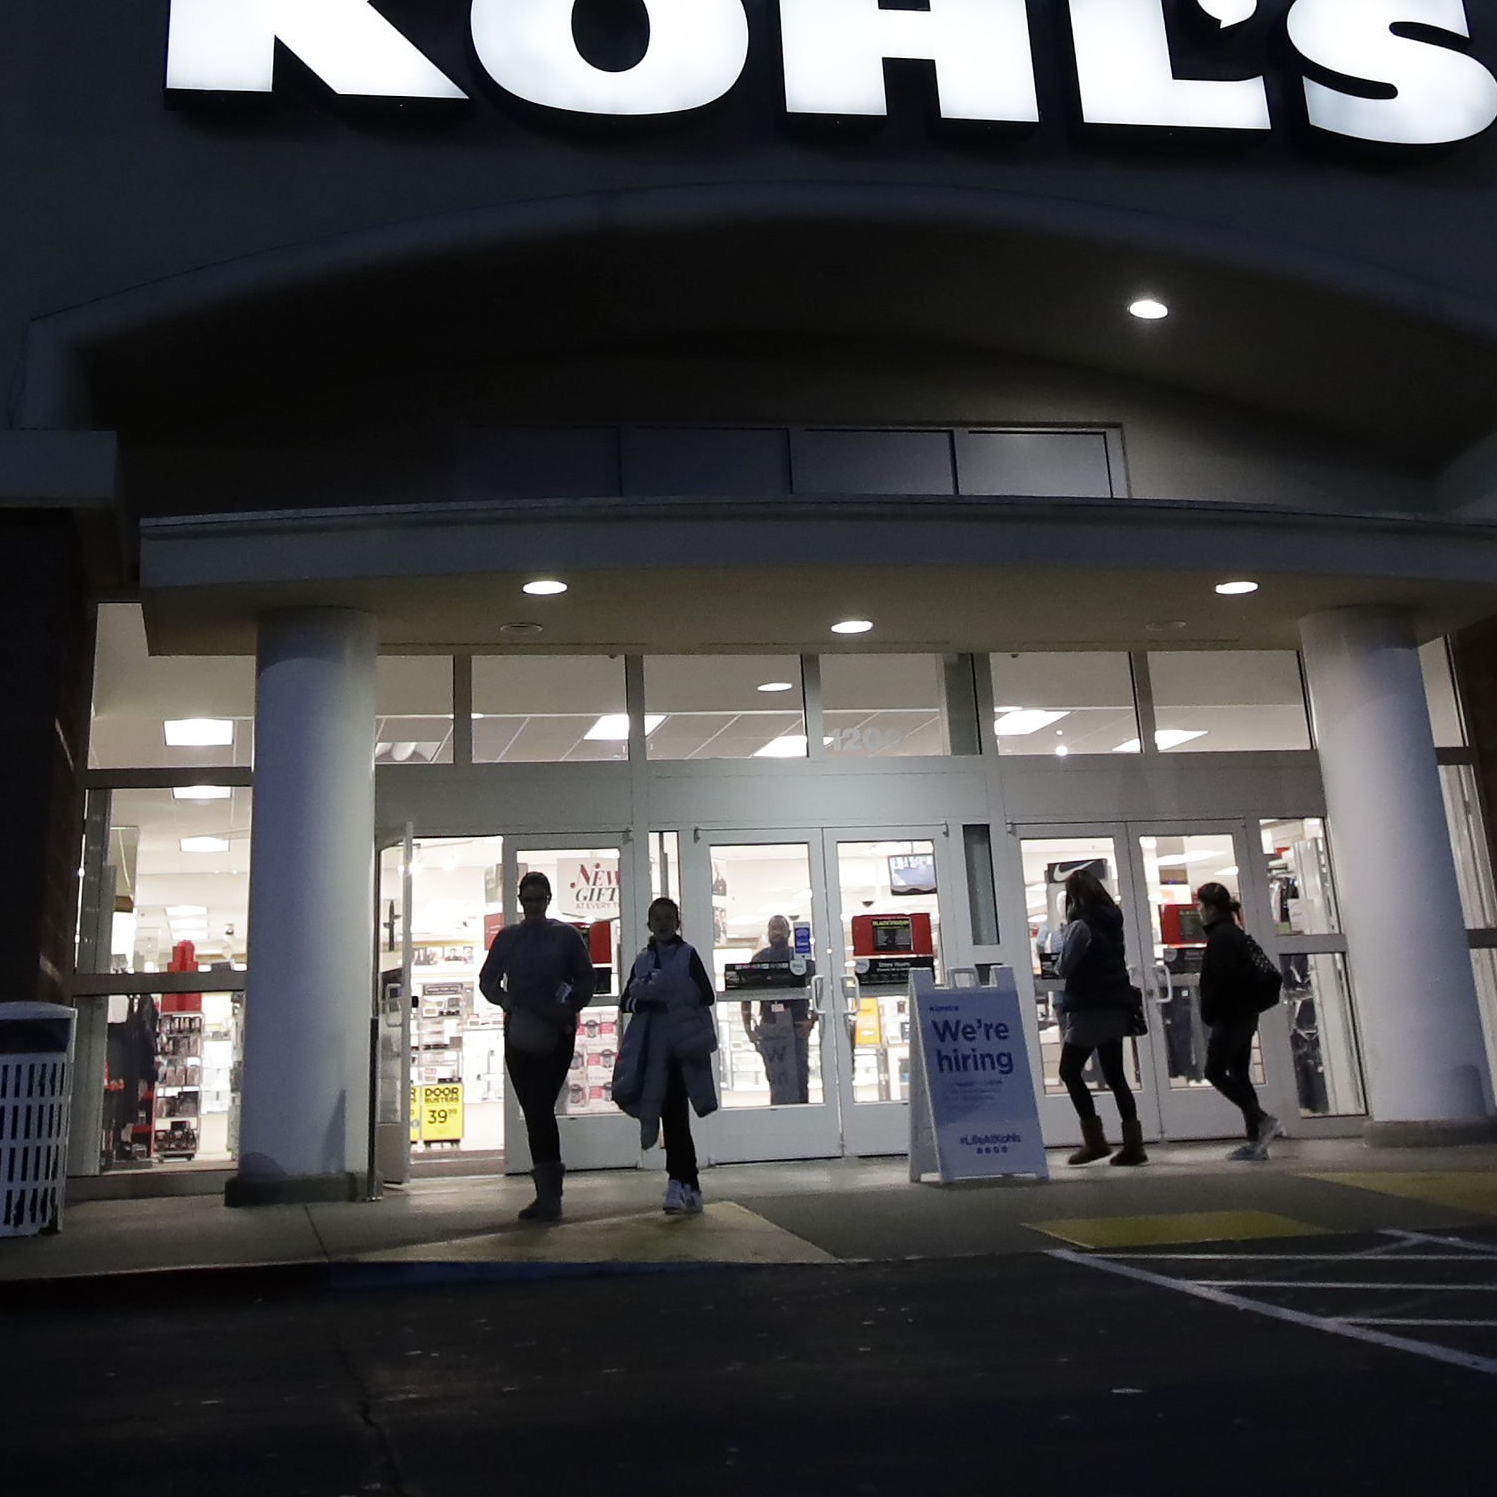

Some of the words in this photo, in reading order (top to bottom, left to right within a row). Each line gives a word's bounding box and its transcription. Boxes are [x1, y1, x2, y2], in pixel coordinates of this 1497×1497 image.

[931, 1018, 1009, 1042] We're
[936, 1048, 1014, 1074] hiring
[424, 1087, 459, 1097] DOOR
